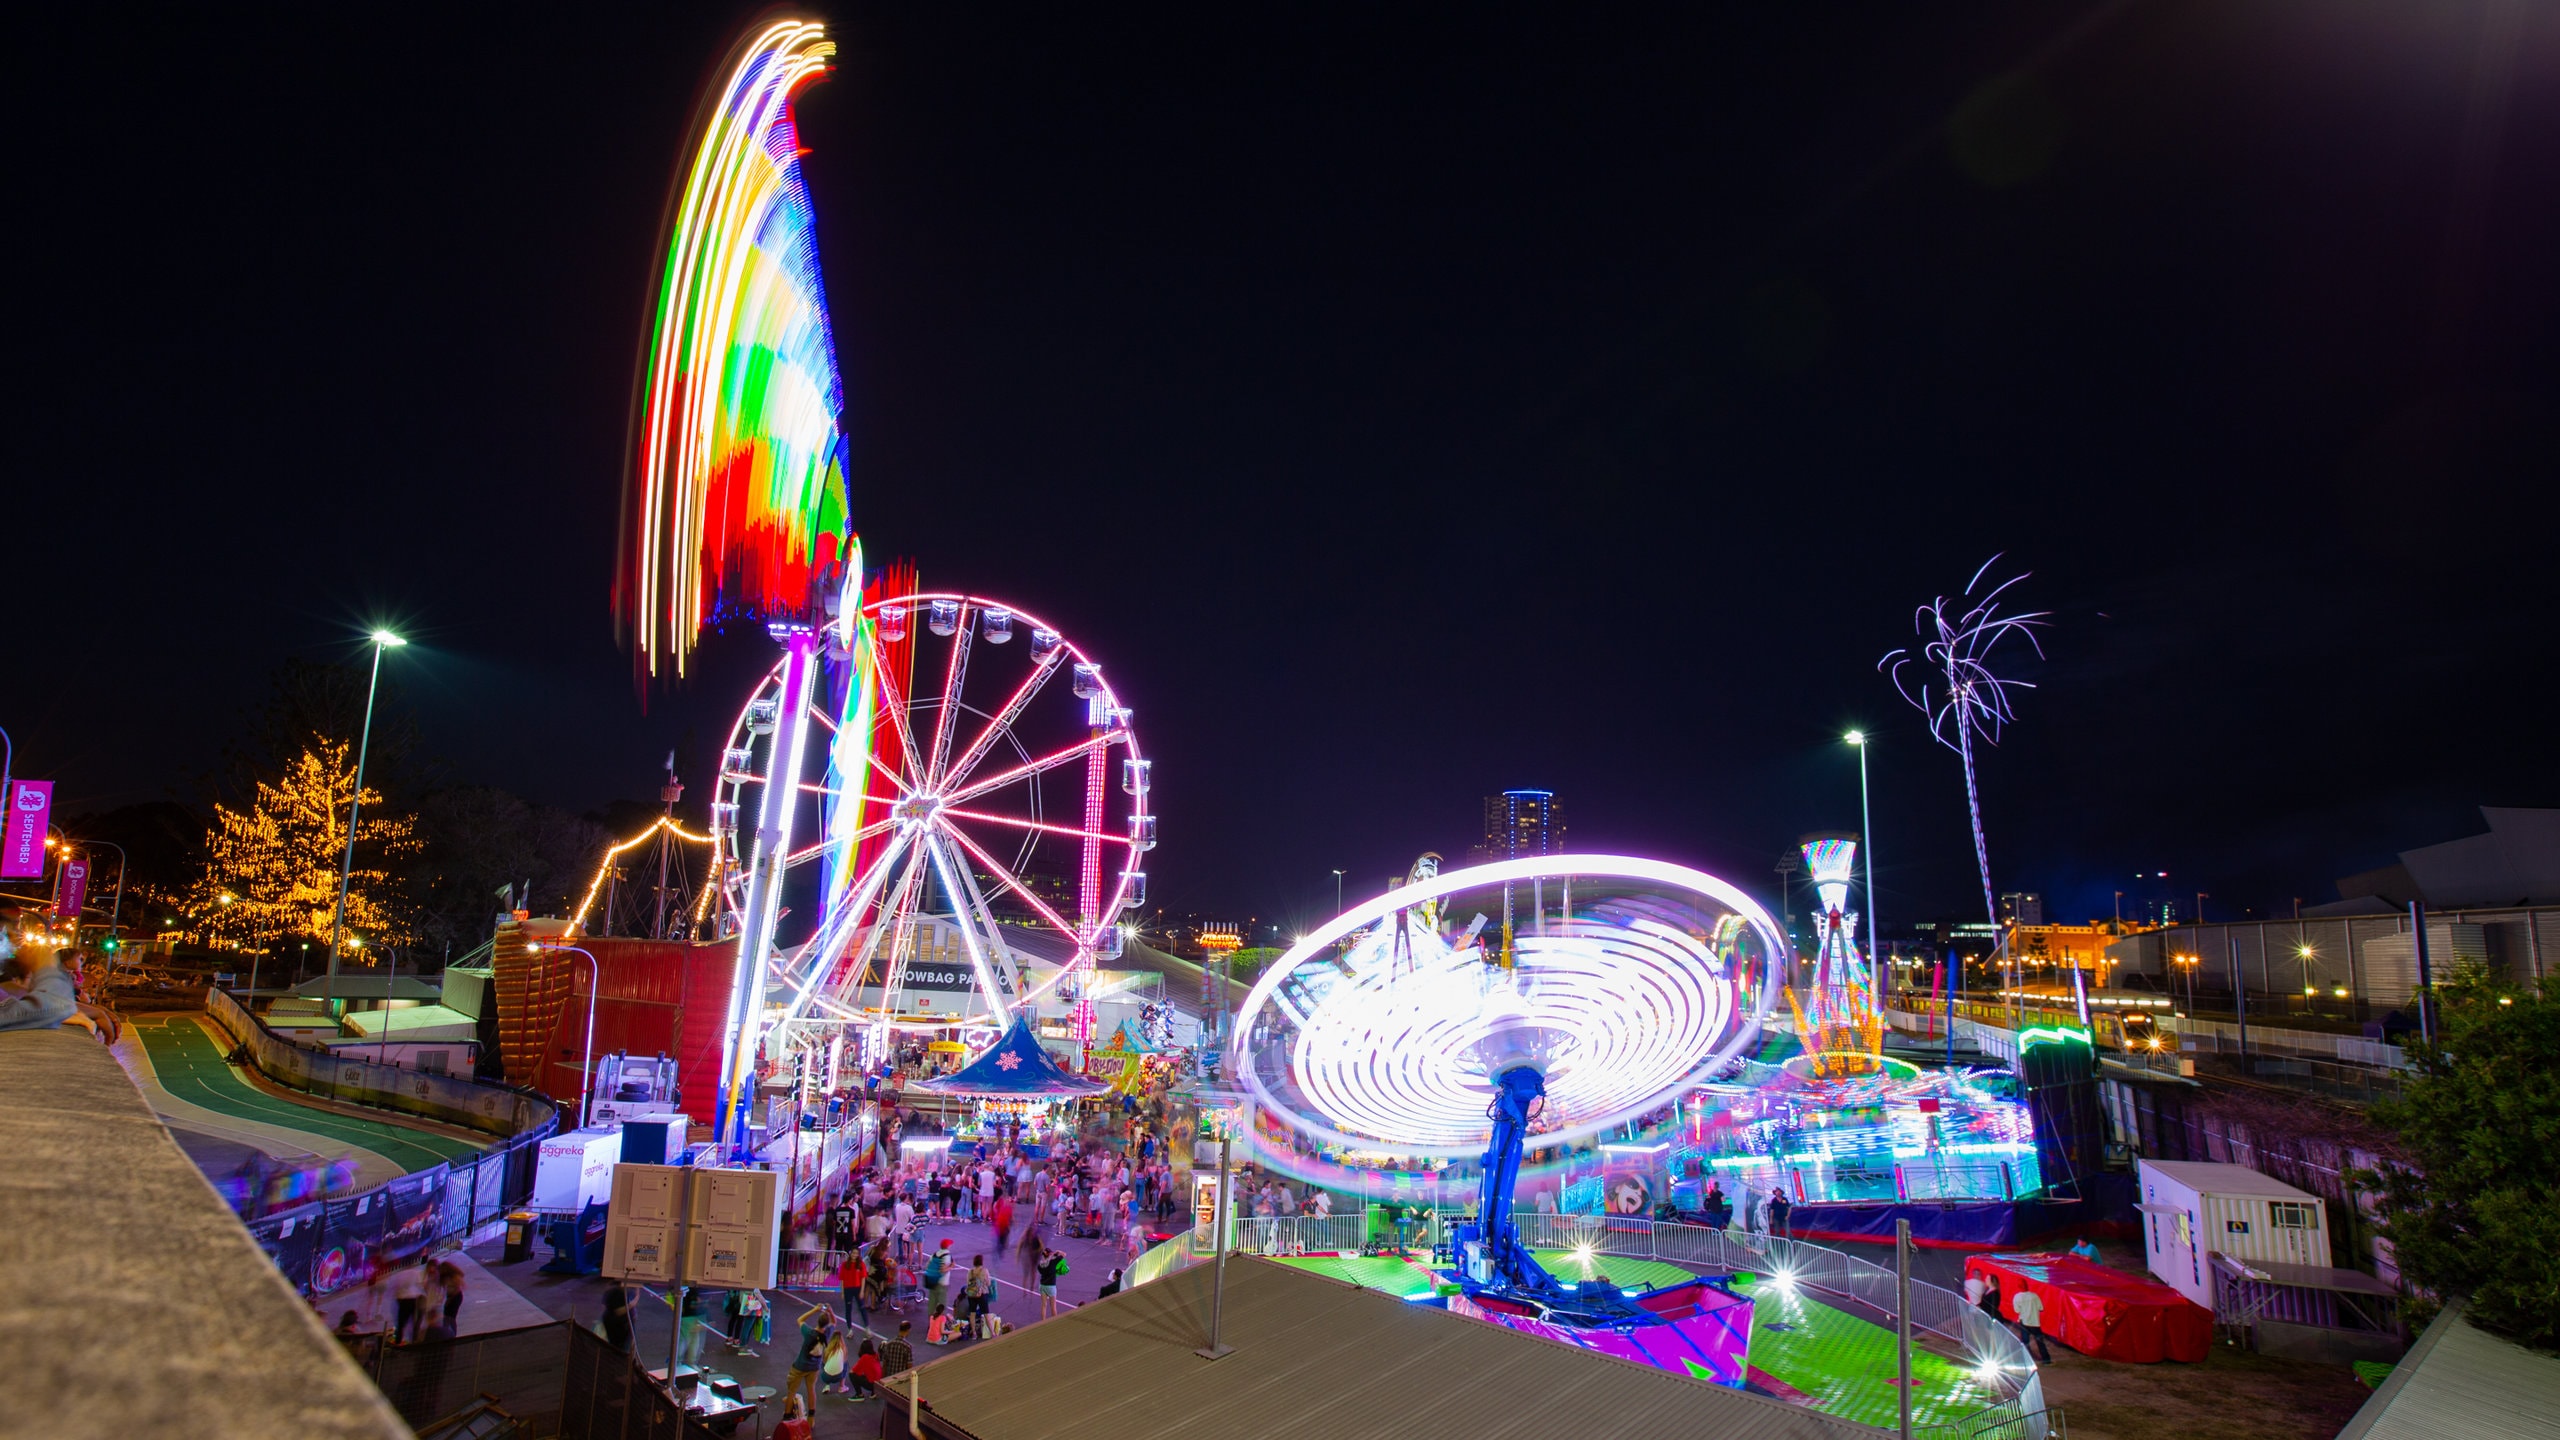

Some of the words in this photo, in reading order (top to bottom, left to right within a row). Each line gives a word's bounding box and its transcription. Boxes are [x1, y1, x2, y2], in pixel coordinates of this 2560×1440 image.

[18, 813, 35, 864] SEPTEMBER
[890, 969, 955, 984] OWBAG
[540, 1145, 585, 1158] aggreko
